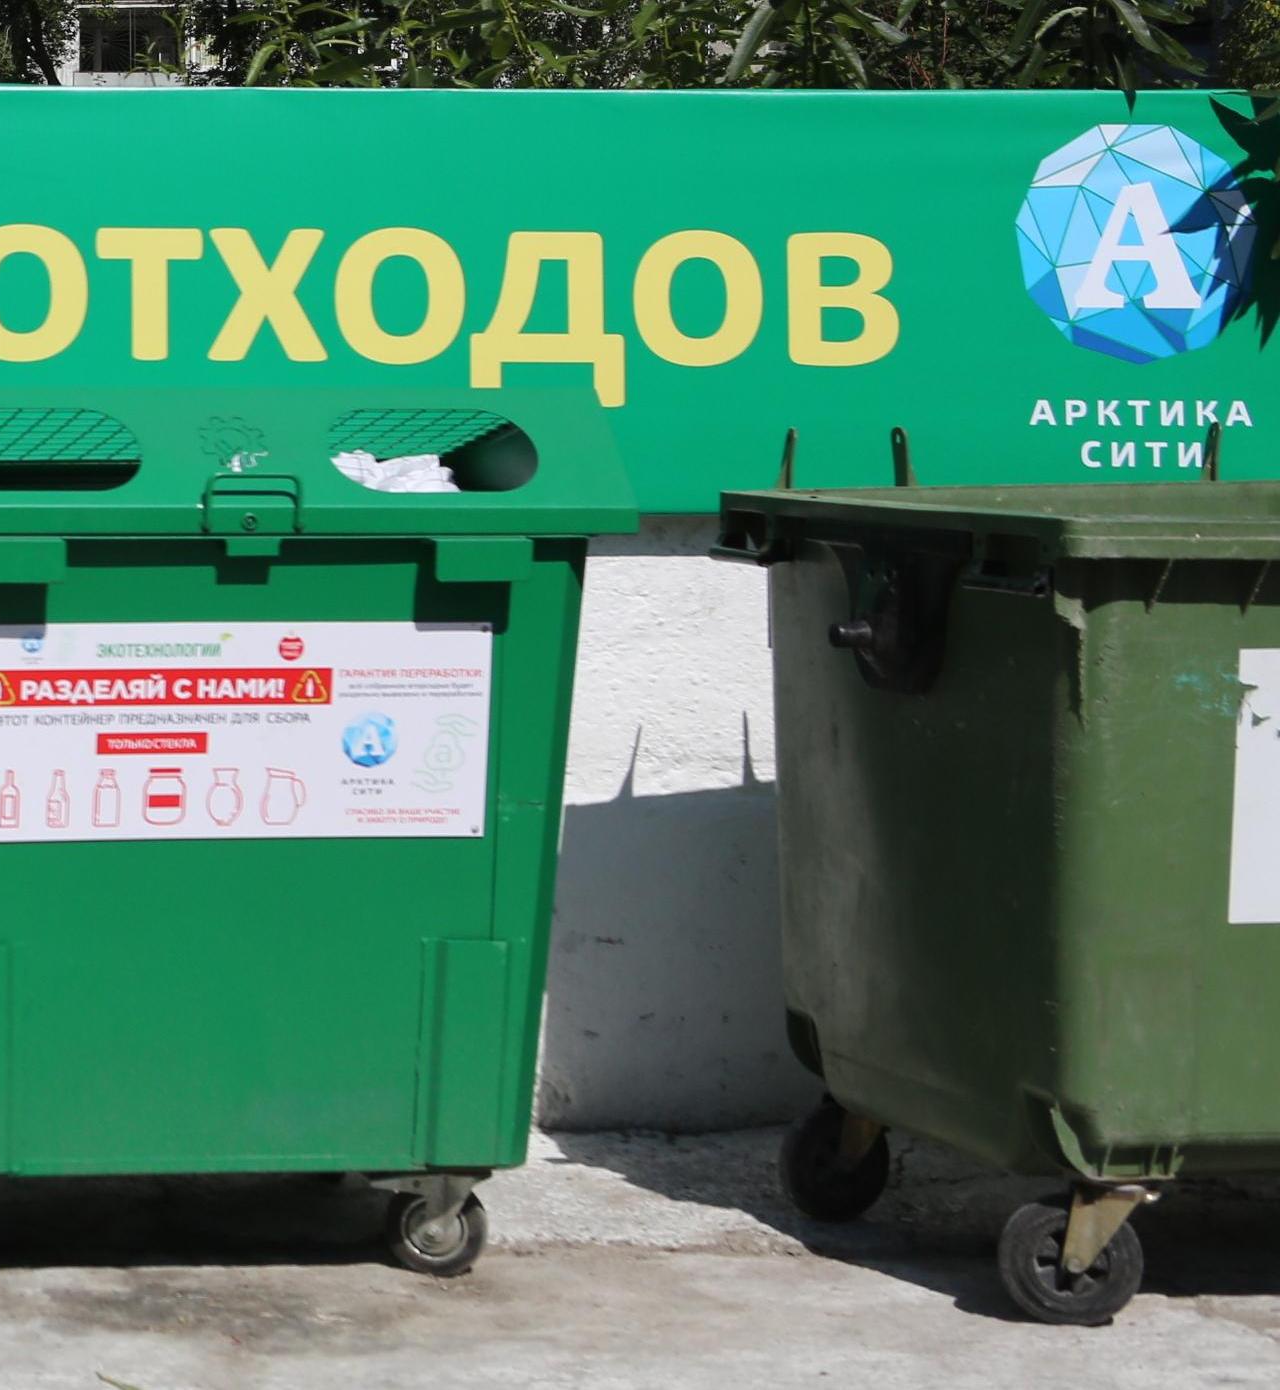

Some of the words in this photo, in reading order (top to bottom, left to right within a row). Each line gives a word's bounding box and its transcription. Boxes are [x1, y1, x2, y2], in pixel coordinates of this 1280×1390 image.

[1029, 399, 1253, 427] АРКТИКА
[1080, 440, 1205, 468] СИТИ
[96, 643, 222, 658] ЭКОТЕХНОЛОГИИ
[20, 673, 167, 704] РАЗДЕЛЯЙ
[173, 678, 192, 699] С
[197, 678, 285, 699] НАМИ!
[34, 711, 115, 726] КОНТЕЙНЕР
[118, 713, 226, 726] ПРЕДНАЗНАЧЕН
[231, 713, 259, 725] ДЛЯ
[267, 712, 310, 724] СБОРА
